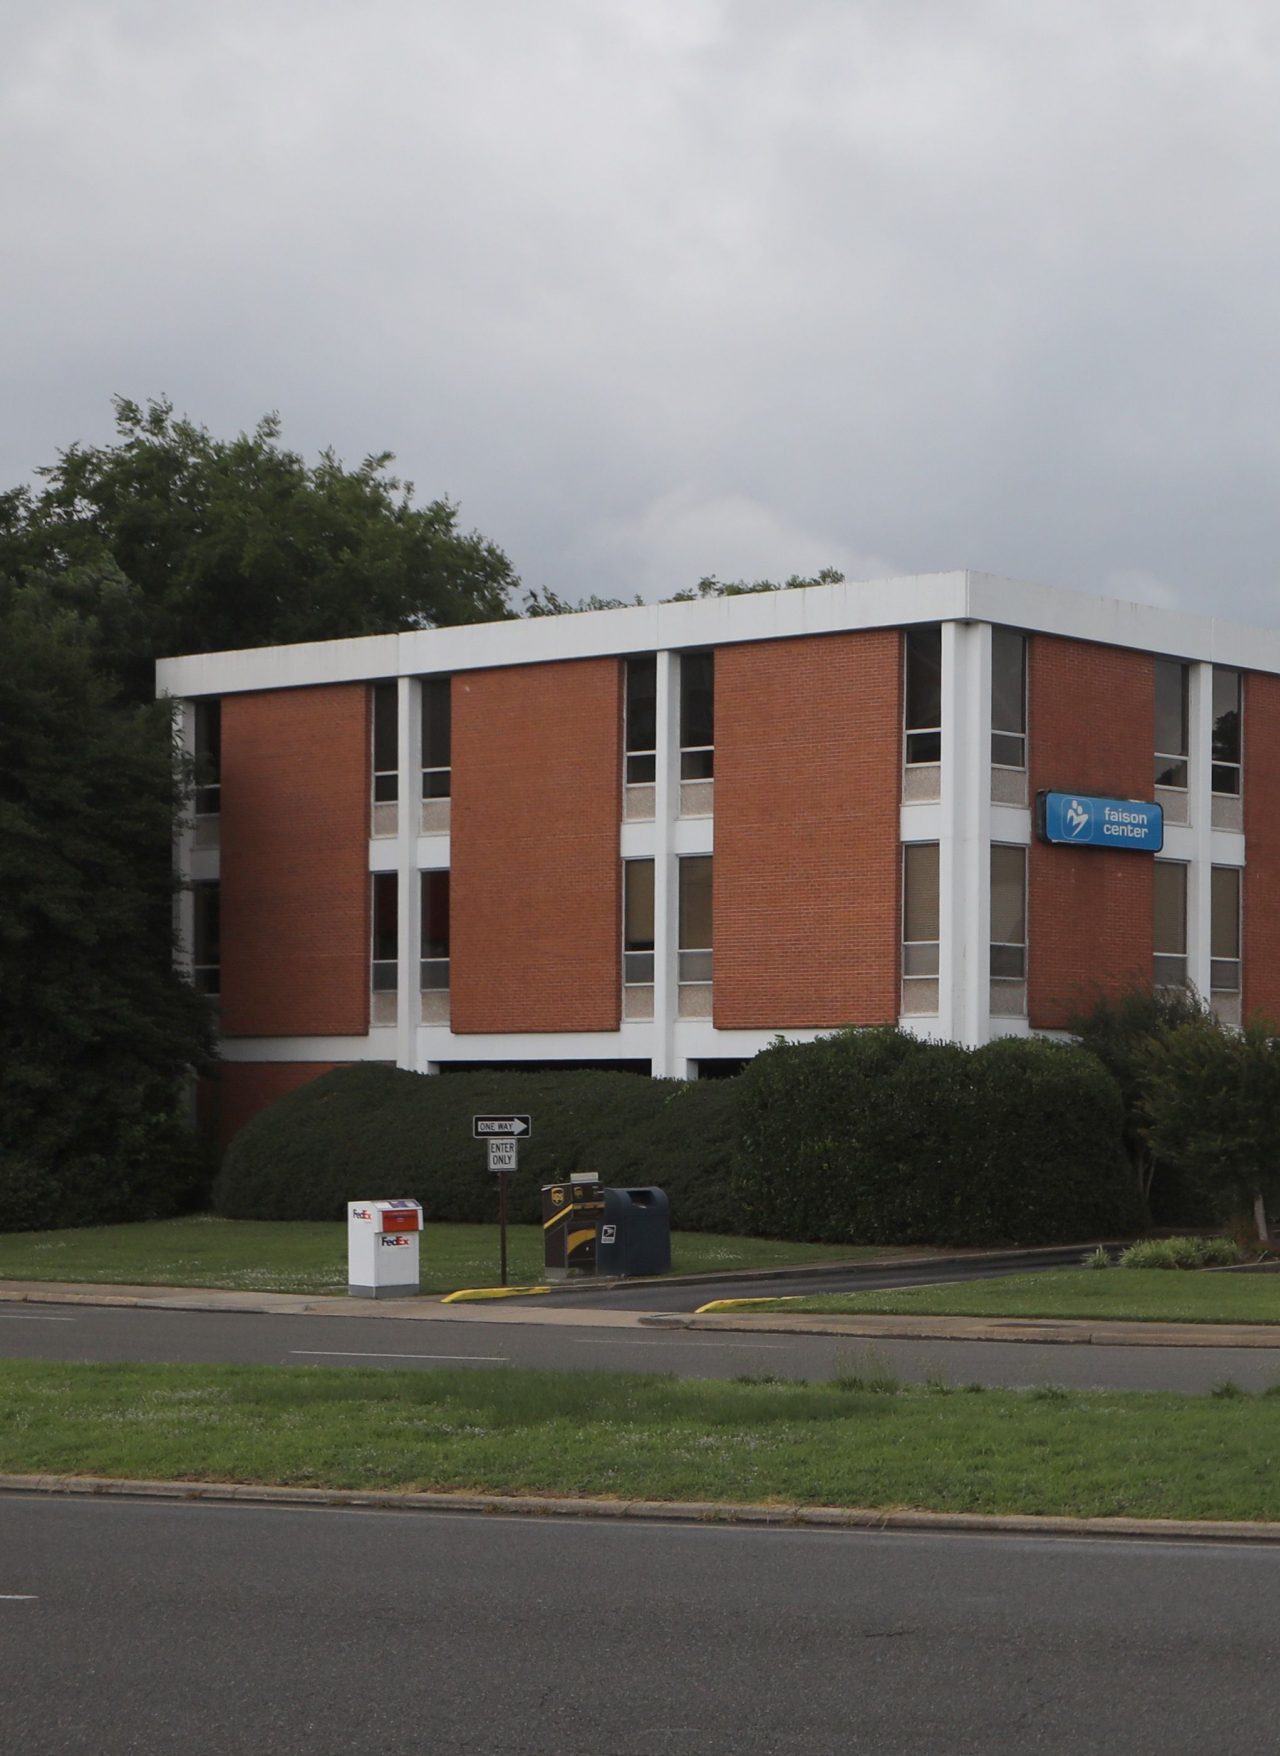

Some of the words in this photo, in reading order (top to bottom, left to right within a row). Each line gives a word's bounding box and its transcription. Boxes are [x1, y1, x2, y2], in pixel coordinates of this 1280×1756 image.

[1104, 807, 1147, 824] faison
[1103, 824, 1149, 838] center
[480, 1122, 495, 1130] ONE
[497, 1122, 514, 1130] WAY
[491, 1143, 514, 1153] ENTER
[492, 1154, 512, 1165] ONLY
[352, 1209, 371, 1220] FedEx
[381, 1236, 409, 1246] FedEx
